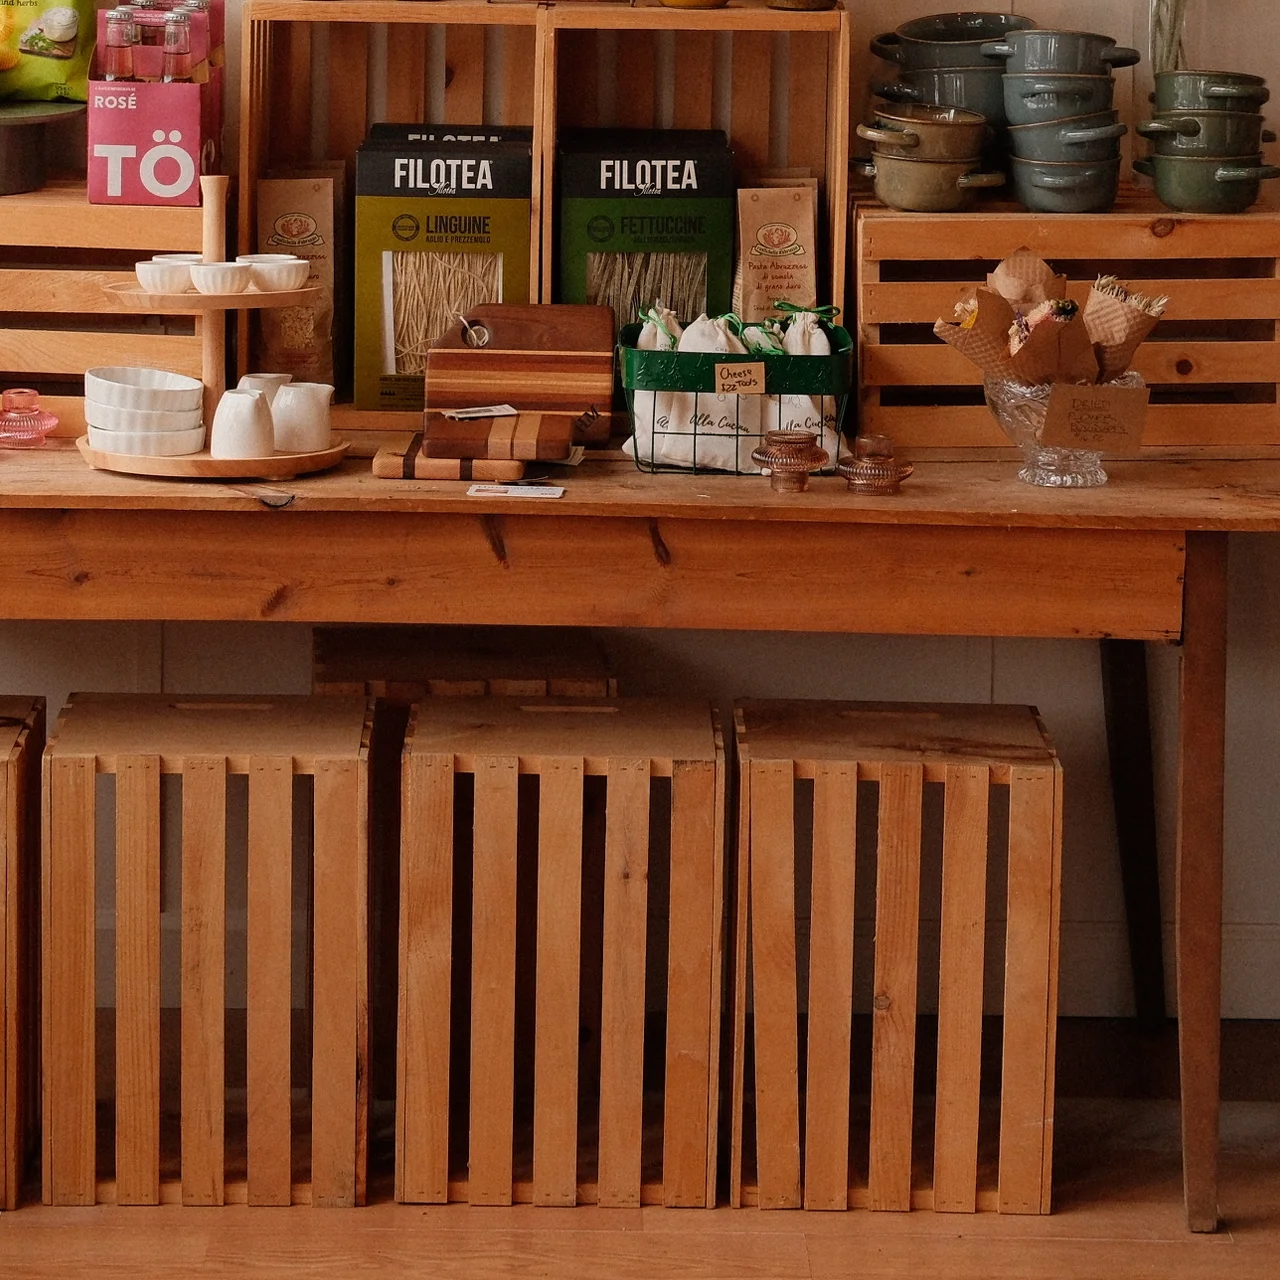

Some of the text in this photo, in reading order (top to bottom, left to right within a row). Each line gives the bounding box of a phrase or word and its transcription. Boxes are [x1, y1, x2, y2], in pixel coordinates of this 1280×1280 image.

[16, 0, 38, 7] herbs
[94, 93, 137, 109] ROSÉ
[94, 130, 195, 198] TÖ
[394, 158, 493, 190] FILOTEA
[600, 160, 698, 190] FILOTEA
[425, 215, 491, 234] LINGUINE
[620, 216, 706, 234] FETTUCCINE
[748, 261, 808, 270] Pasta Abruzzese
[761, 272, 769, 280] di
[755, 282, 802, 292] di grano duro
[719, 367, 752, 380] Cheese
[721, 378, 759, 393] $22 Tools
